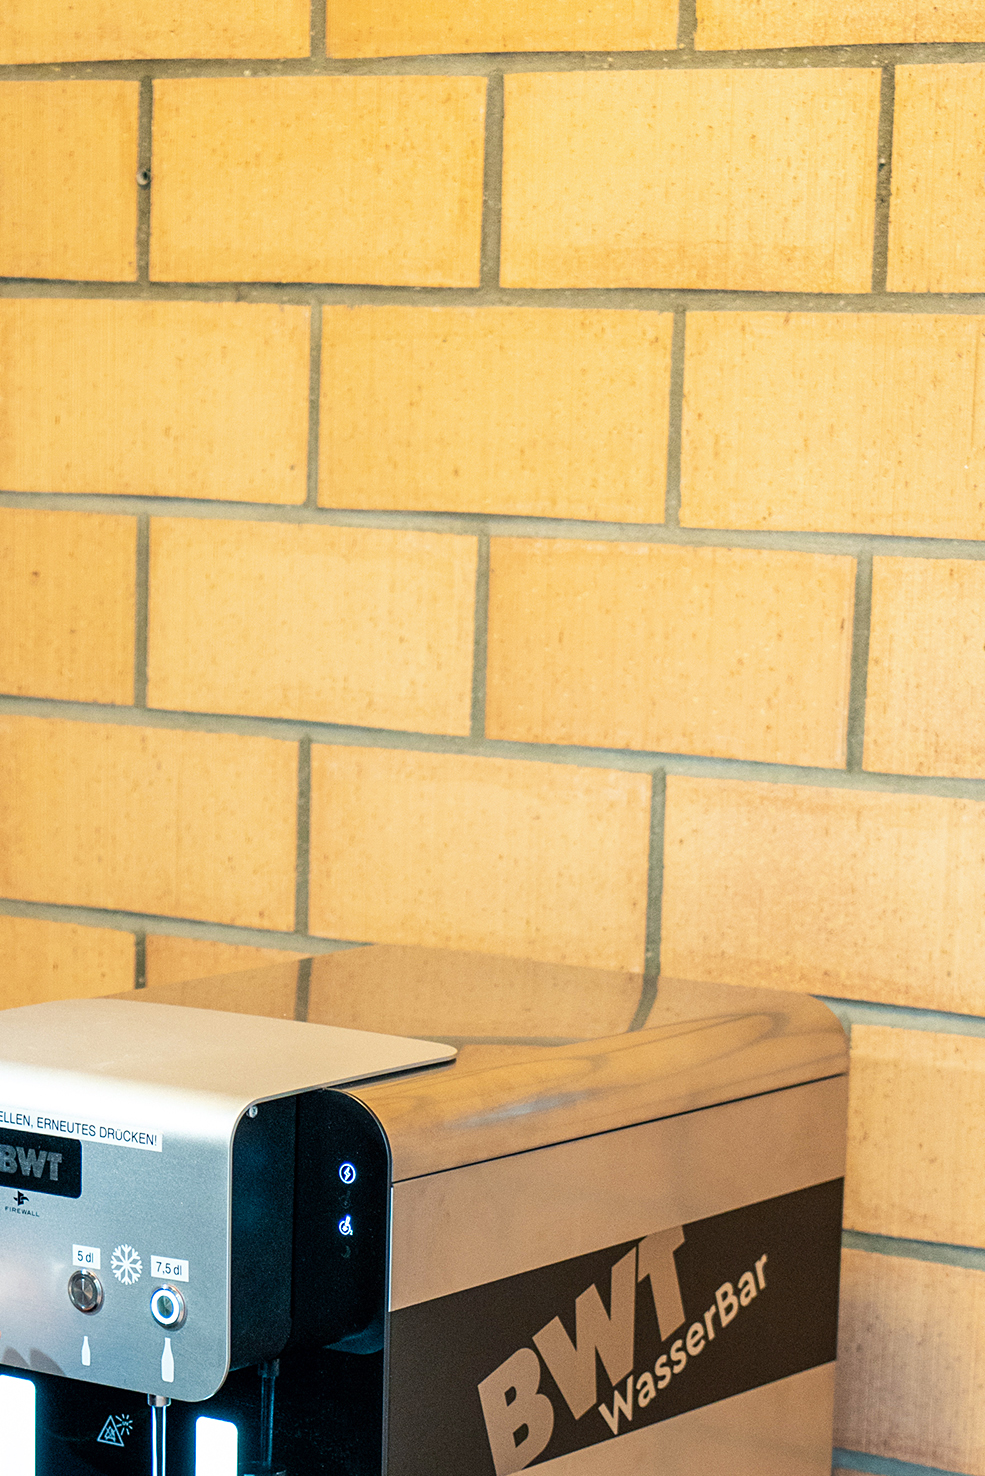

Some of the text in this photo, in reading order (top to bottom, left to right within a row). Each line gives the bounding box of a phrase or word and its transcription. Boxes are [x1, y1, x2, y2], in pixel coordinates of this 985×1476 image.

[37, 1117, 96, 1137] ERNEUTES
[99, 1125, 157, 1146] DRÜCKEN!
[0, 1144, 63, 1181] BWT
[5, 1206, 40, 1218] FIREWALL
[77, 1251, 94, 1264] 5 dl
[155, 1262, 182, 1277] 7,5 dl
[598, 1254, 768, 1436] WasserBar
